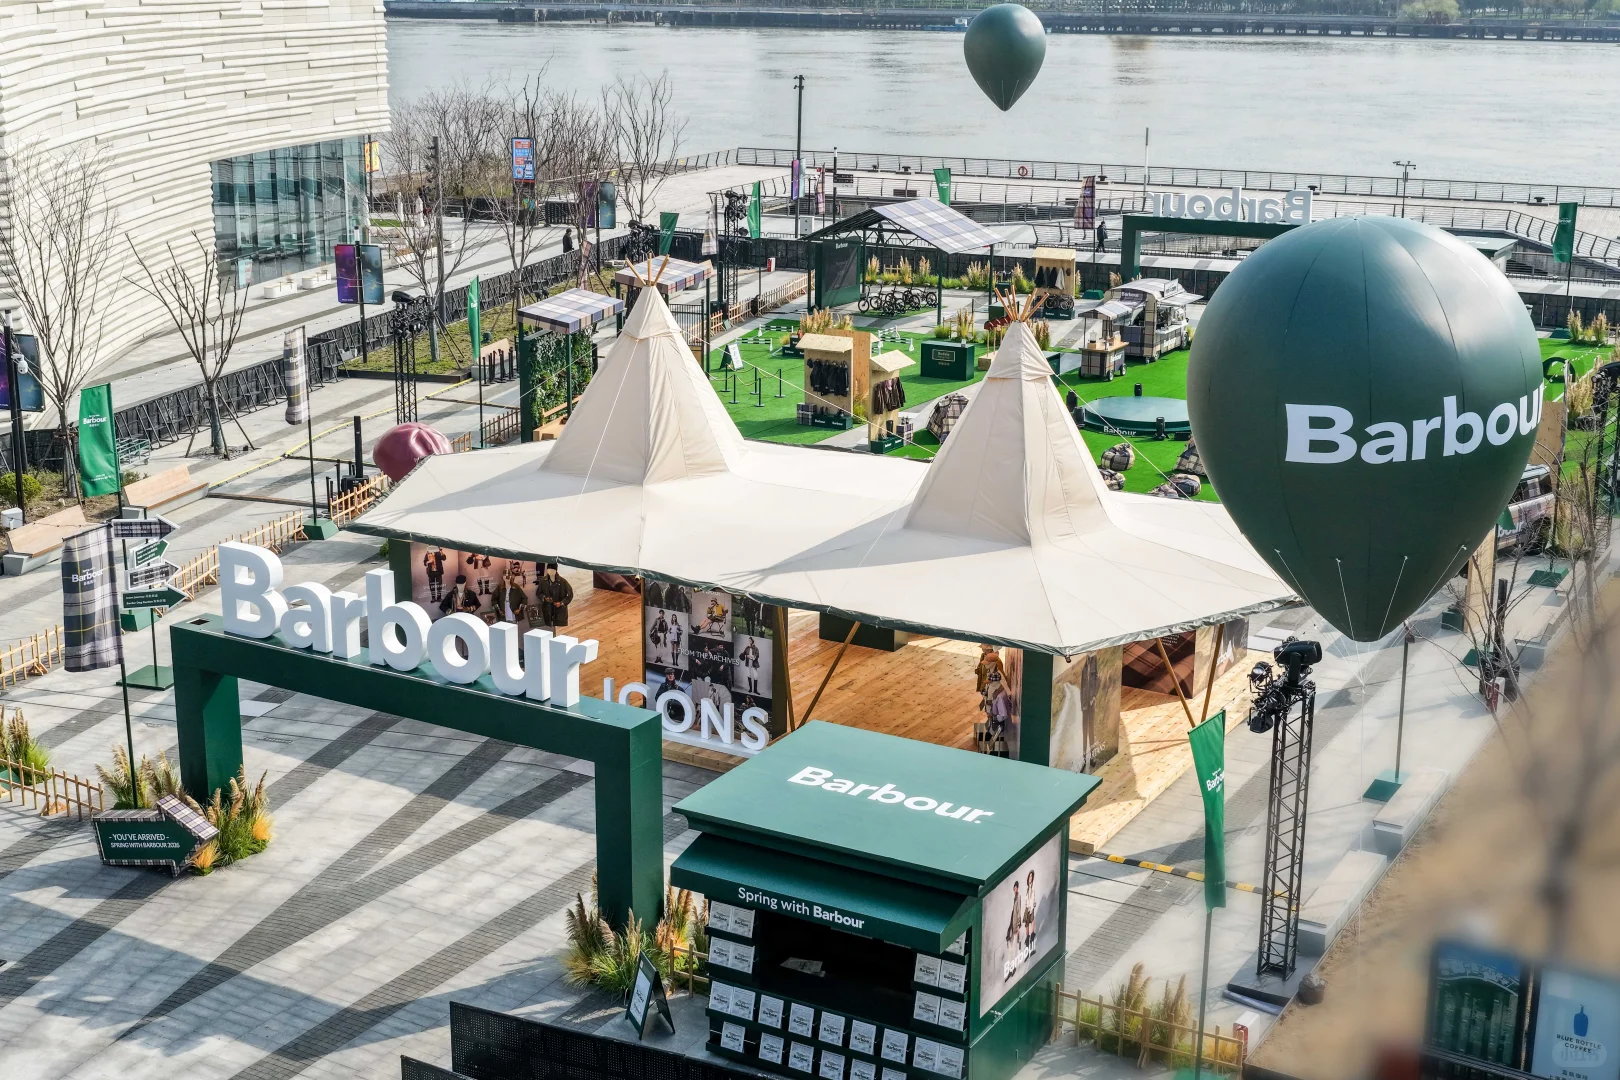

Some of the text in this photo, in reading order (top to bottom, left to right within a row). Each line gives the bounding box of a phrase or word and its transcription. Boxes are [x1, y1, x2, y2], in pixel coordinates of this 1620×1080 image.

[83, 416, 107, 425] Barbour
[71, 570, 104, 583] Barbour
[219, 541, 599, 707] Barbour
[677, 647, 740, 666] FROM THE ARCHIVES
[112, 833, 138, 841] YOU'VE
[137, 833, 166, 841] ARRIVED
[738, 886, 865, 929] Spring with Barbour
[1003, 937, 1037, 979] Barbour
[1556, 1033, 1602, 1050] BLUE BOTTLE
[1564, 1042, 1592, 1054] COFFEE
